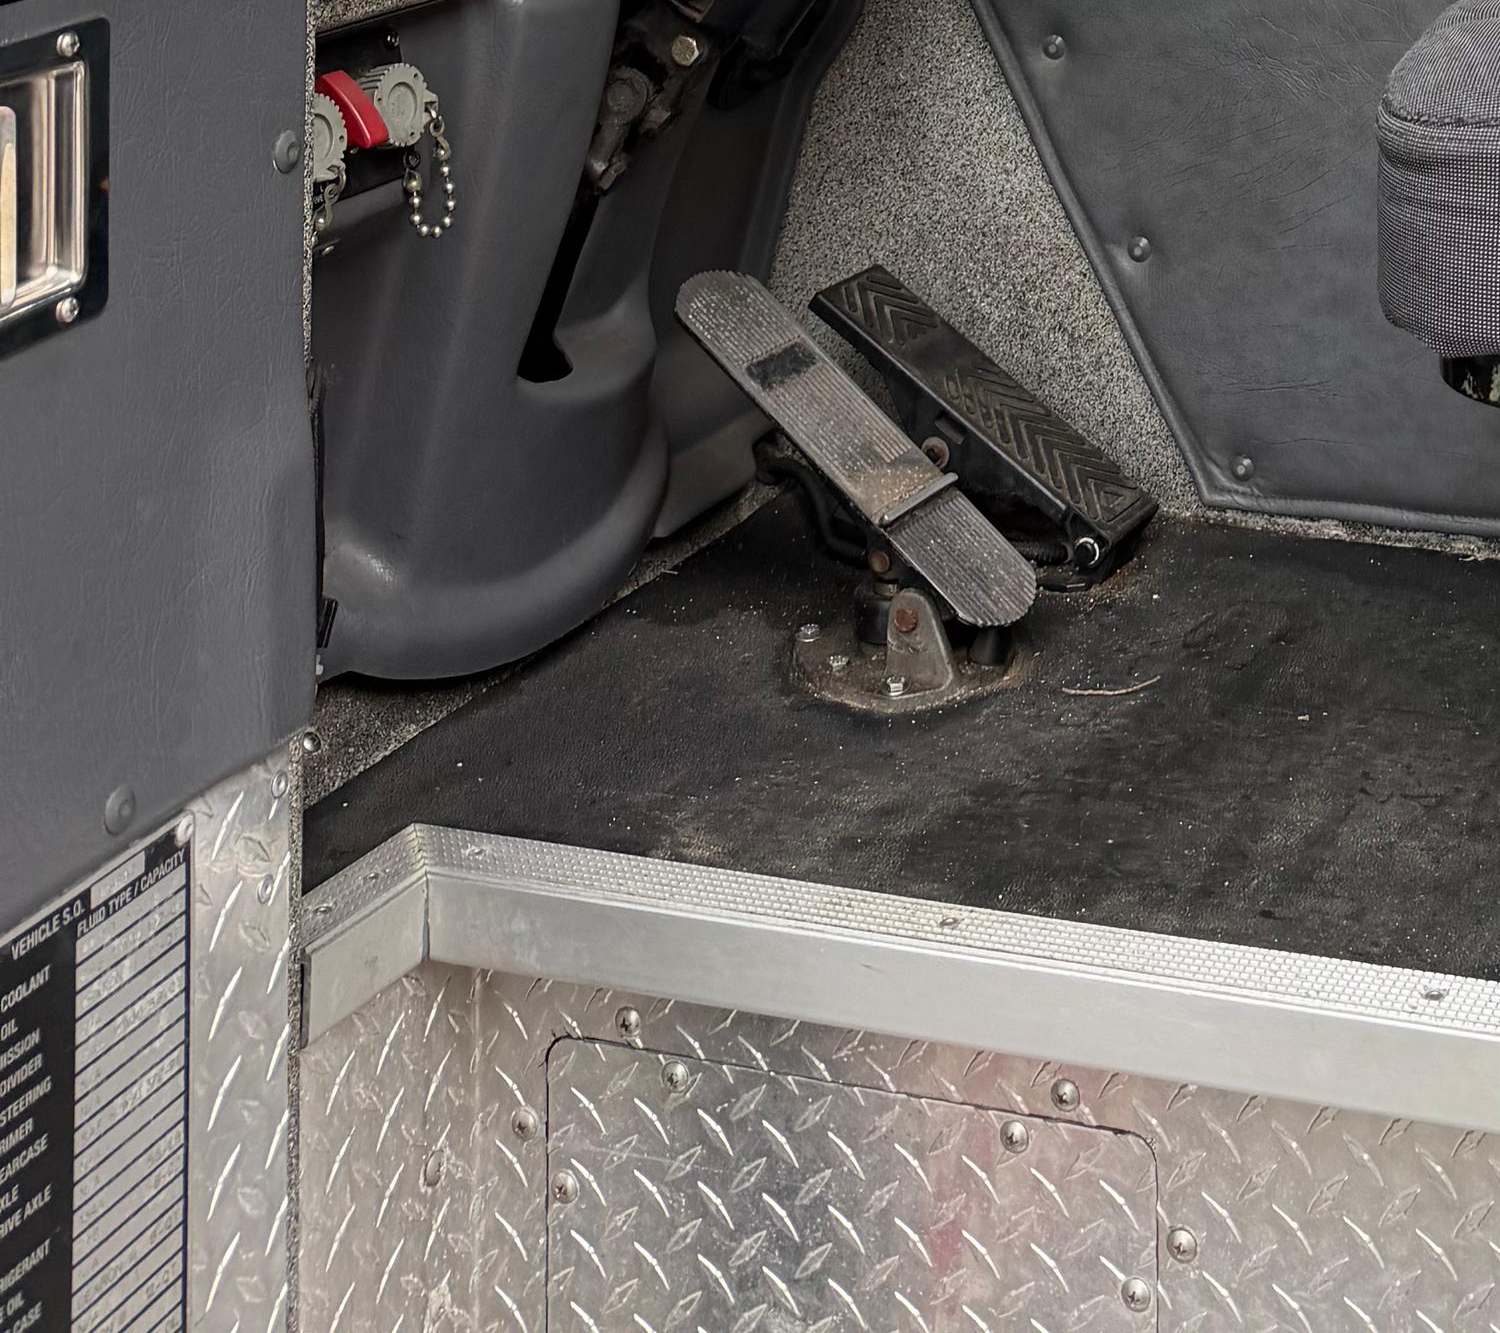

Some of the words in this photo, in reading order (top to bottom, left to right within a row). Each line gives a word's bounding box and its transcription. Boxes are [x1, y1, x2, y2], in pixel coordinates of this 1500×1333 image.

[76, 906, 106, 938] FLUID
[107, 889, 133, 921] TYPE
[140, 848, 187, 893] CAPACITY
[11, 912, 61, 961] VEHICLE
[62, 898, 86, 928] S.O.
[0, 964, 52, 1014] COOLANT
[0, 1017, 19, 1042] OIL
[0, 1052, 43, 1099] DIVIDER
[0, 1075, 53, 1127] STEERING
[23, 1183, 52, 1221] AXLE
[6, 1290, 25, 1317] OIL
